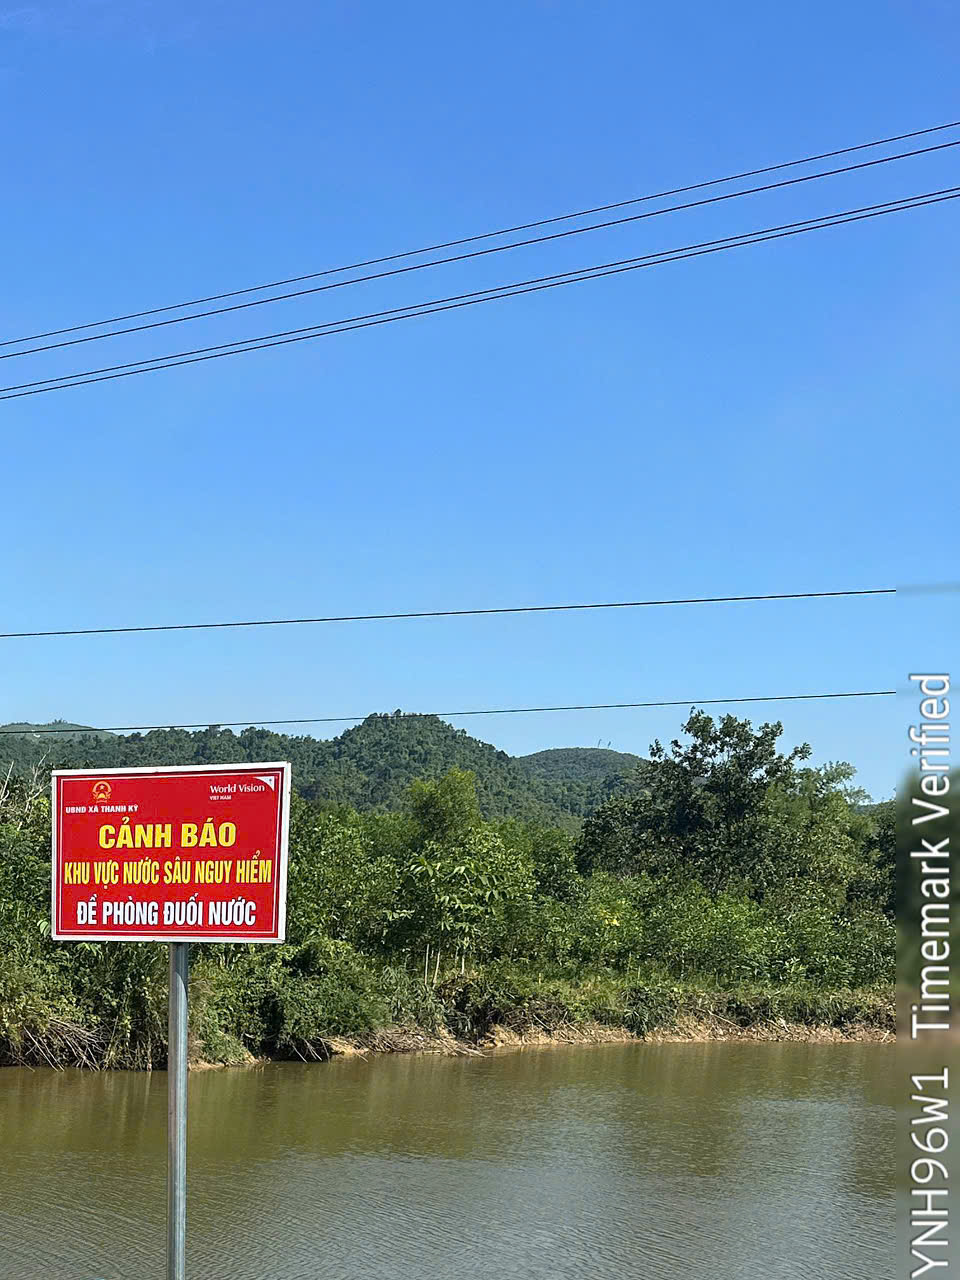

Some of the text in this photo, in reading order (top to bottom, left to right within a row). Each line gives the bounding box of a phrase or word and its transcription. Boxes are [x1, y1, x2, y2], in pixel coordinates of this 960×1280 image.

[210, 783, 265, 793] World Vision
[101, 805, 126, 813] THANH
[99, 816, 237, 849] CẢNH BÁO
[64, 850, 272, 889] KHU VỰC NƯỚC SÂU NGUY HIỂM
[76, 893, 257, 926] ĐỀ PHÒNG ĐUỐI NƯỚC
